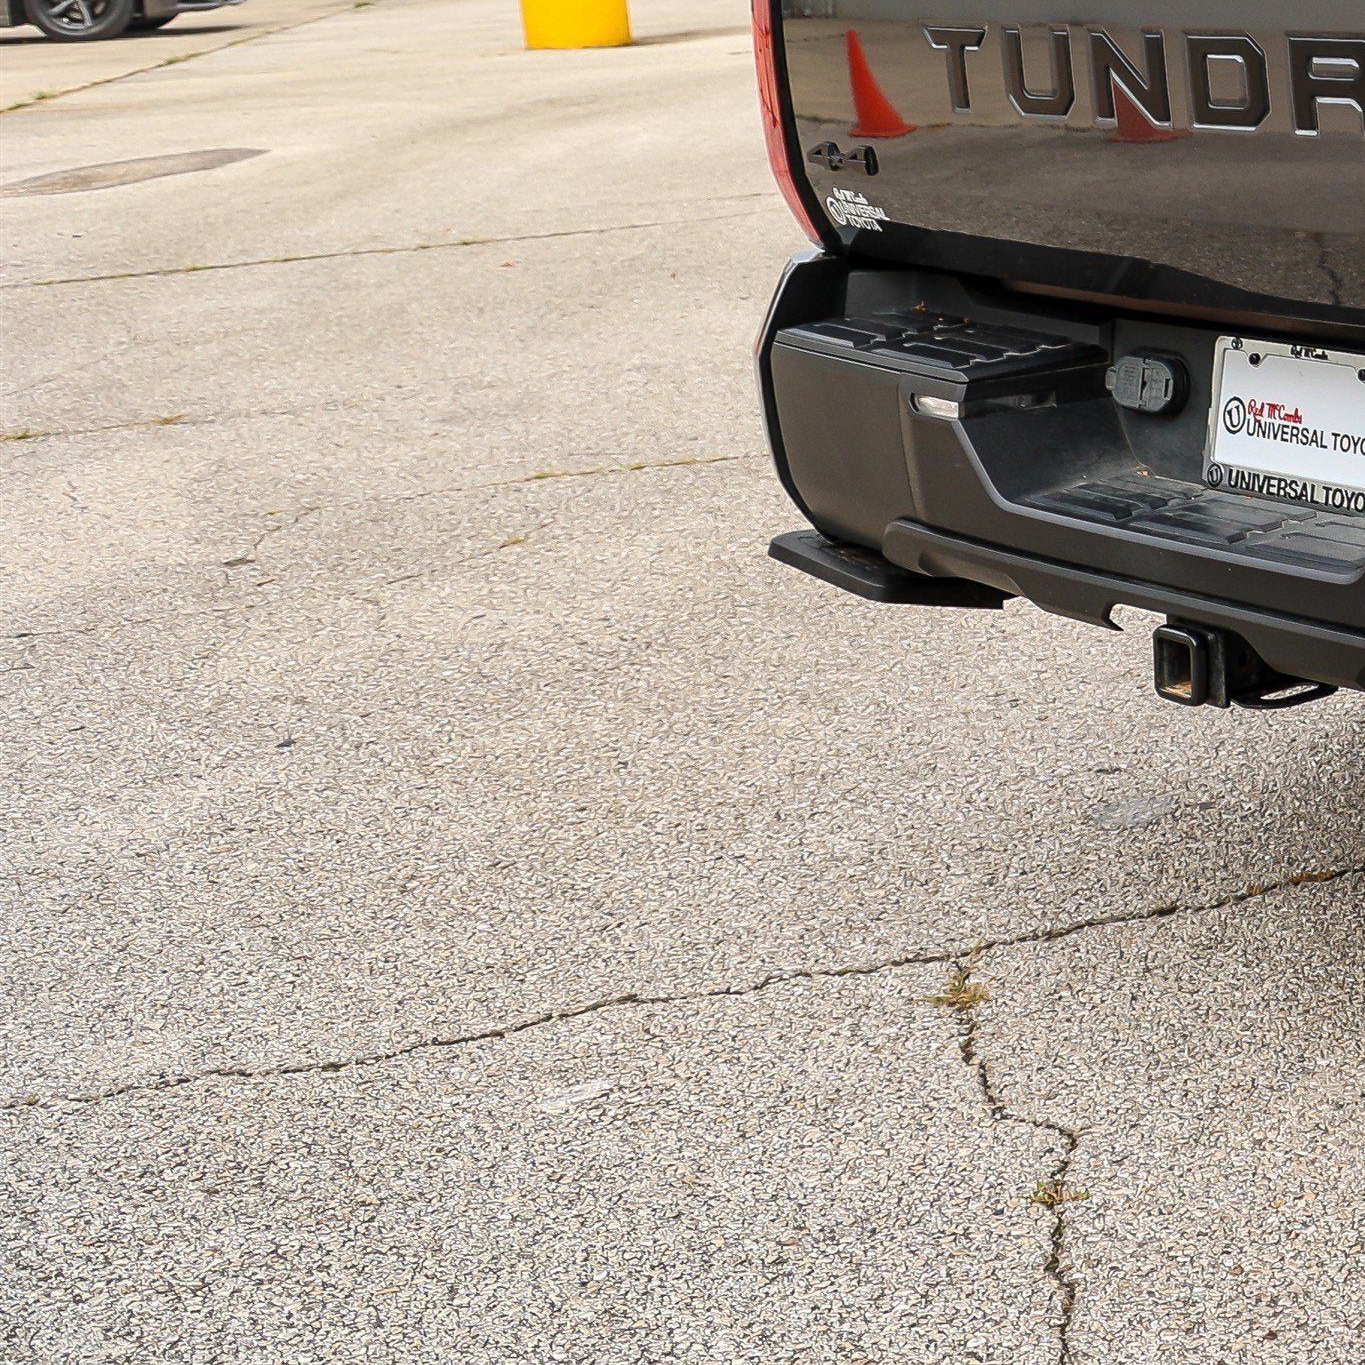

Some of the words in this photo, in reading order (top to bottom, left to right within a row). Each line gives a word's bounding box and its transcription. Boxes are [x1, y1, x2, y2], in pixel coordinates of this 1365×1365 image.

[839, 199, 891, 221] UNIVERSAL
[845, 214, 883, 232] TOYOTA
[1246, 418, 1328, 449] UNIVERSAL
[1227, 467, 1320, 505] UNIVERSAL
